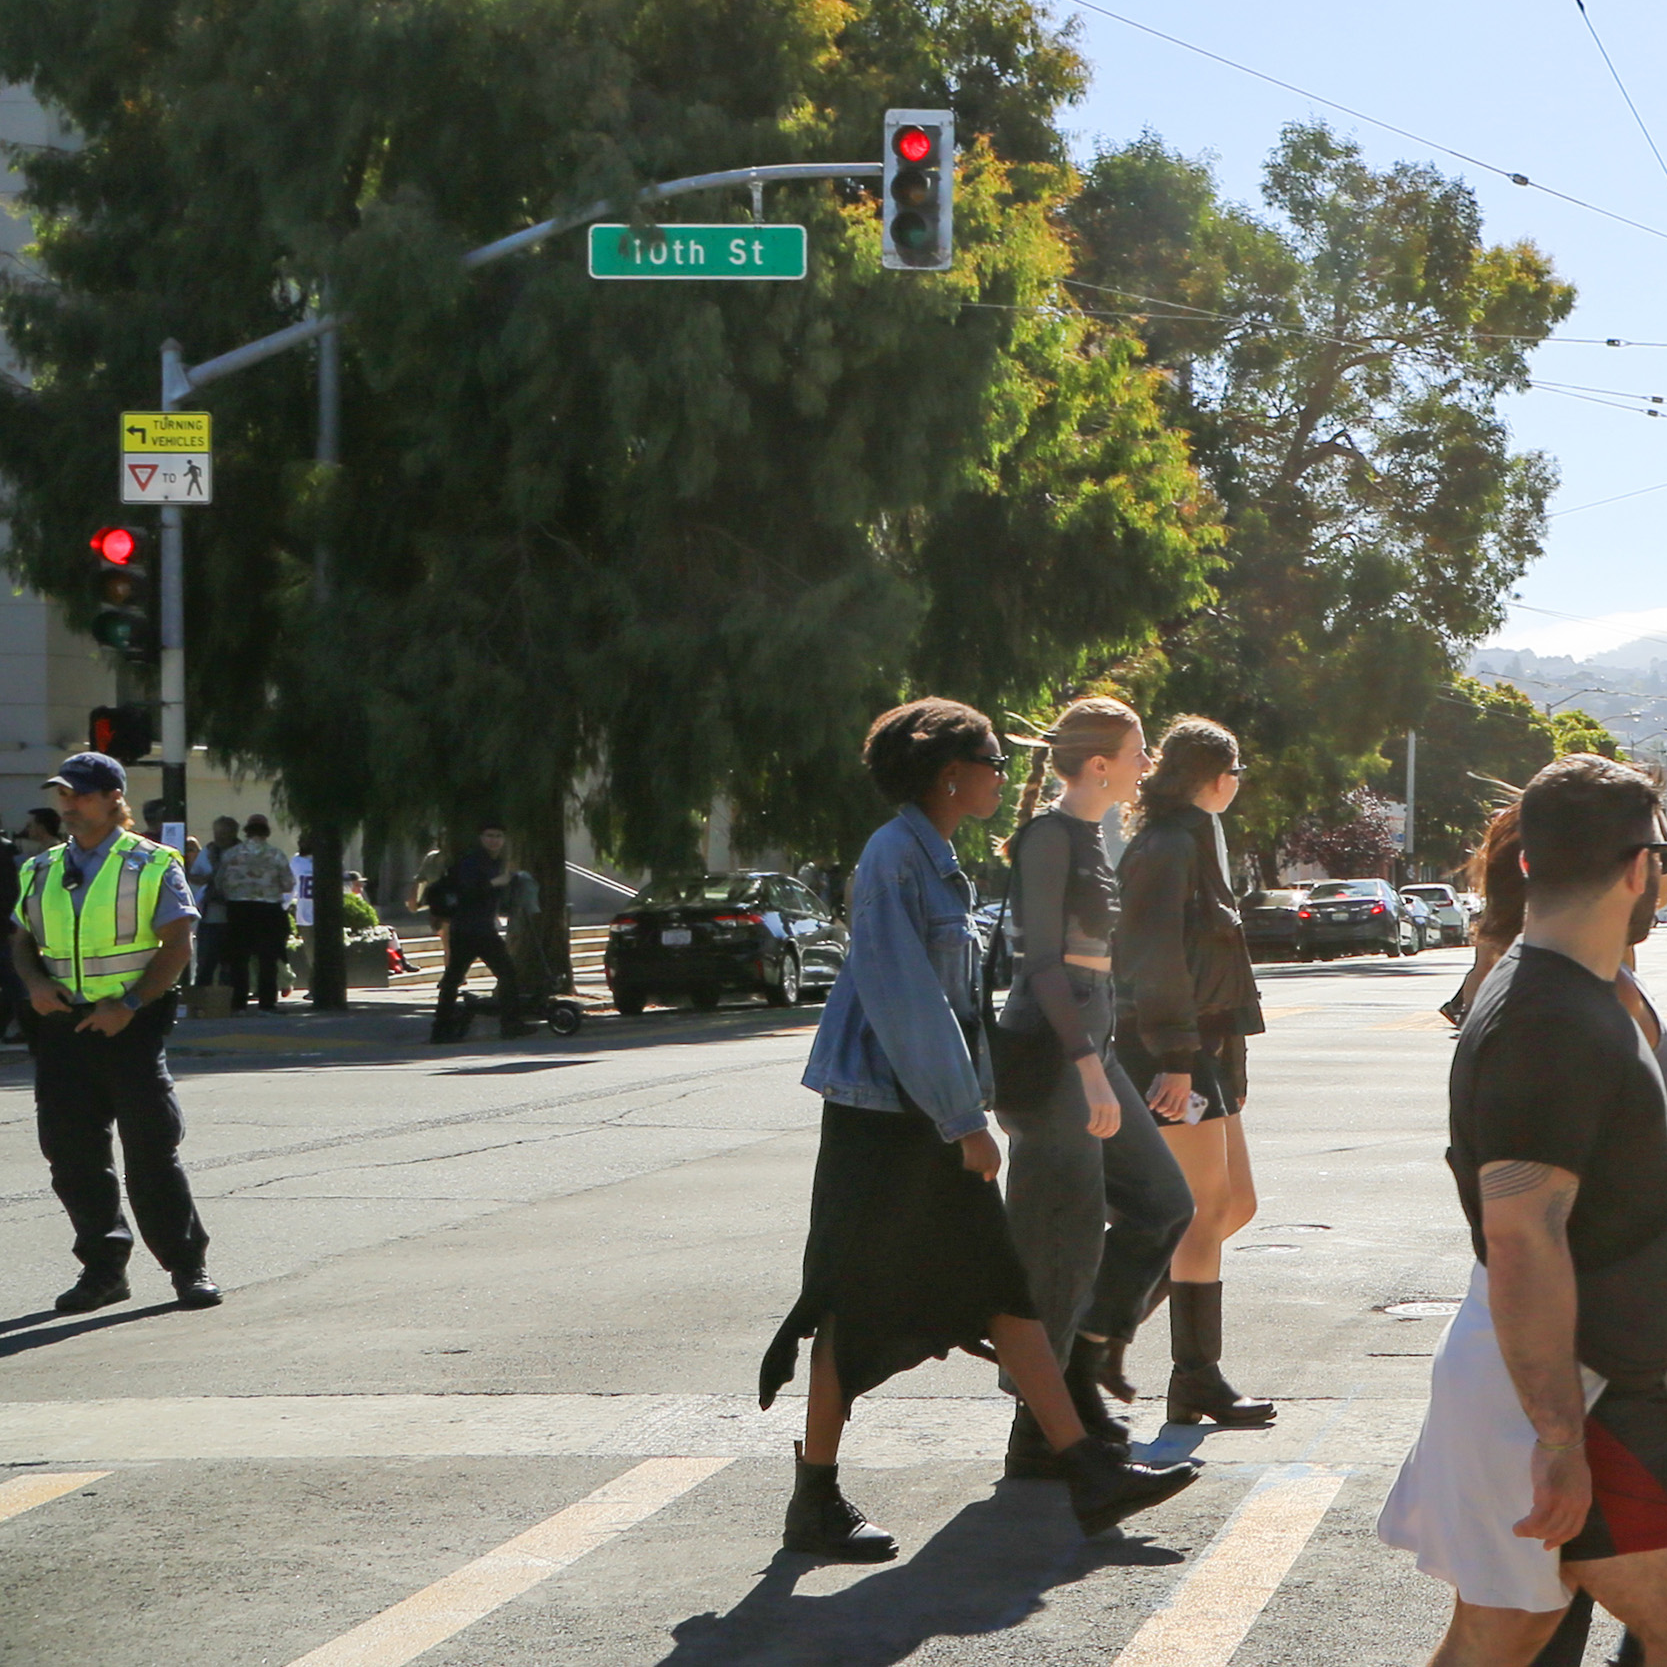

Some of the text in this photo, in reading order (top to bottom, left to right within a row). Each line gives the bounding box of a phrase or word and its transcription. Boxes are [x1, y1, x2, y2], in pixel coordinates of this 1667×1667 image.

[633, 239, 764, 265] 10th St
[153, 420, 204, 430] TURNING
[151, 437, 205, 446] VEHICLES
[162, 473, 177, 483] TO
